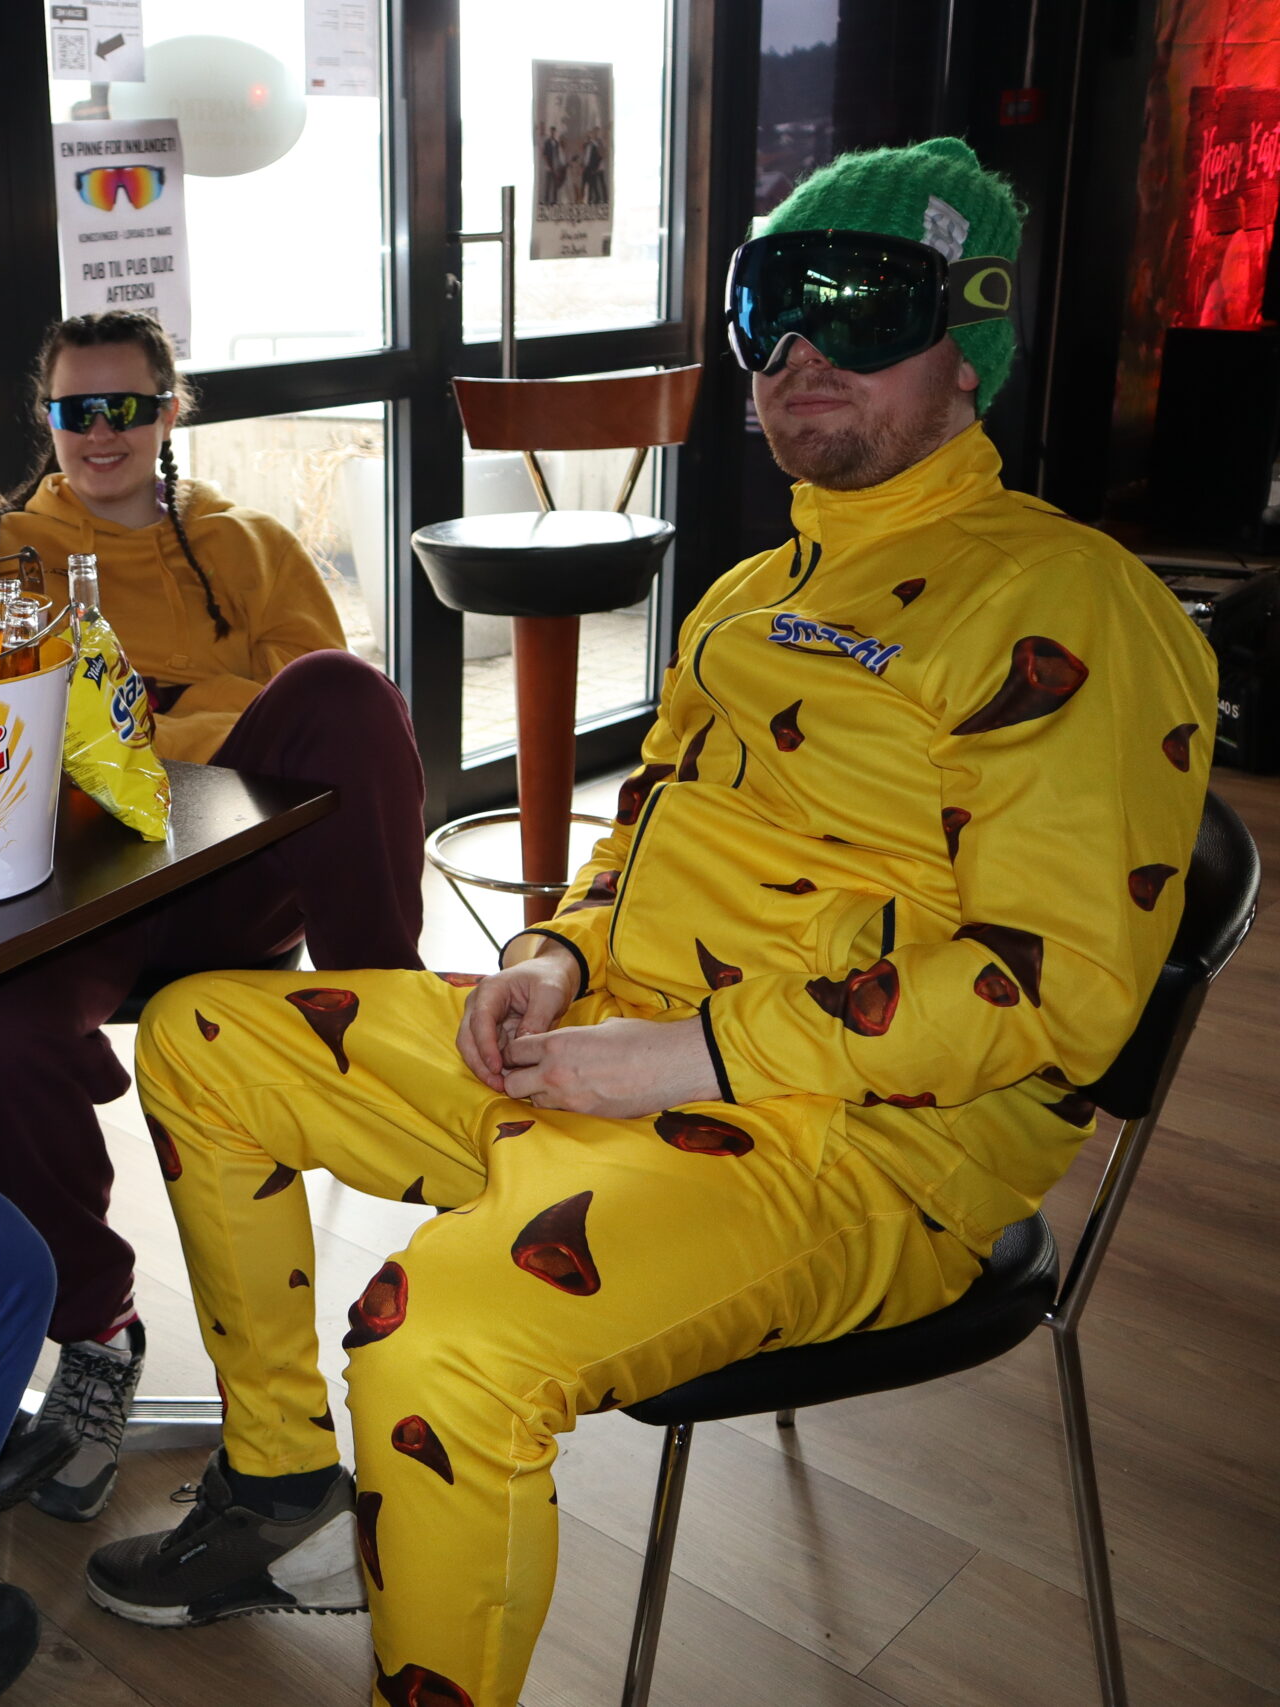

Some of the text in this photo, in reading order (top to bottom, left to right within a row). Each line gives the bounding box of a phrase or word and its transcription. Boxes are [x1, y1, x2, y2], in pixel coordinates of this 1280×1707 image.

[61, 142, 74, 157] EN
[76, 141, 102, 156] PINNE
[1198, 125, 1243, 199] Happy
[83, 255, 174, 281] PUB TIL PUB QUIZ
[106, 282, 154, 303] AFTERSKI
